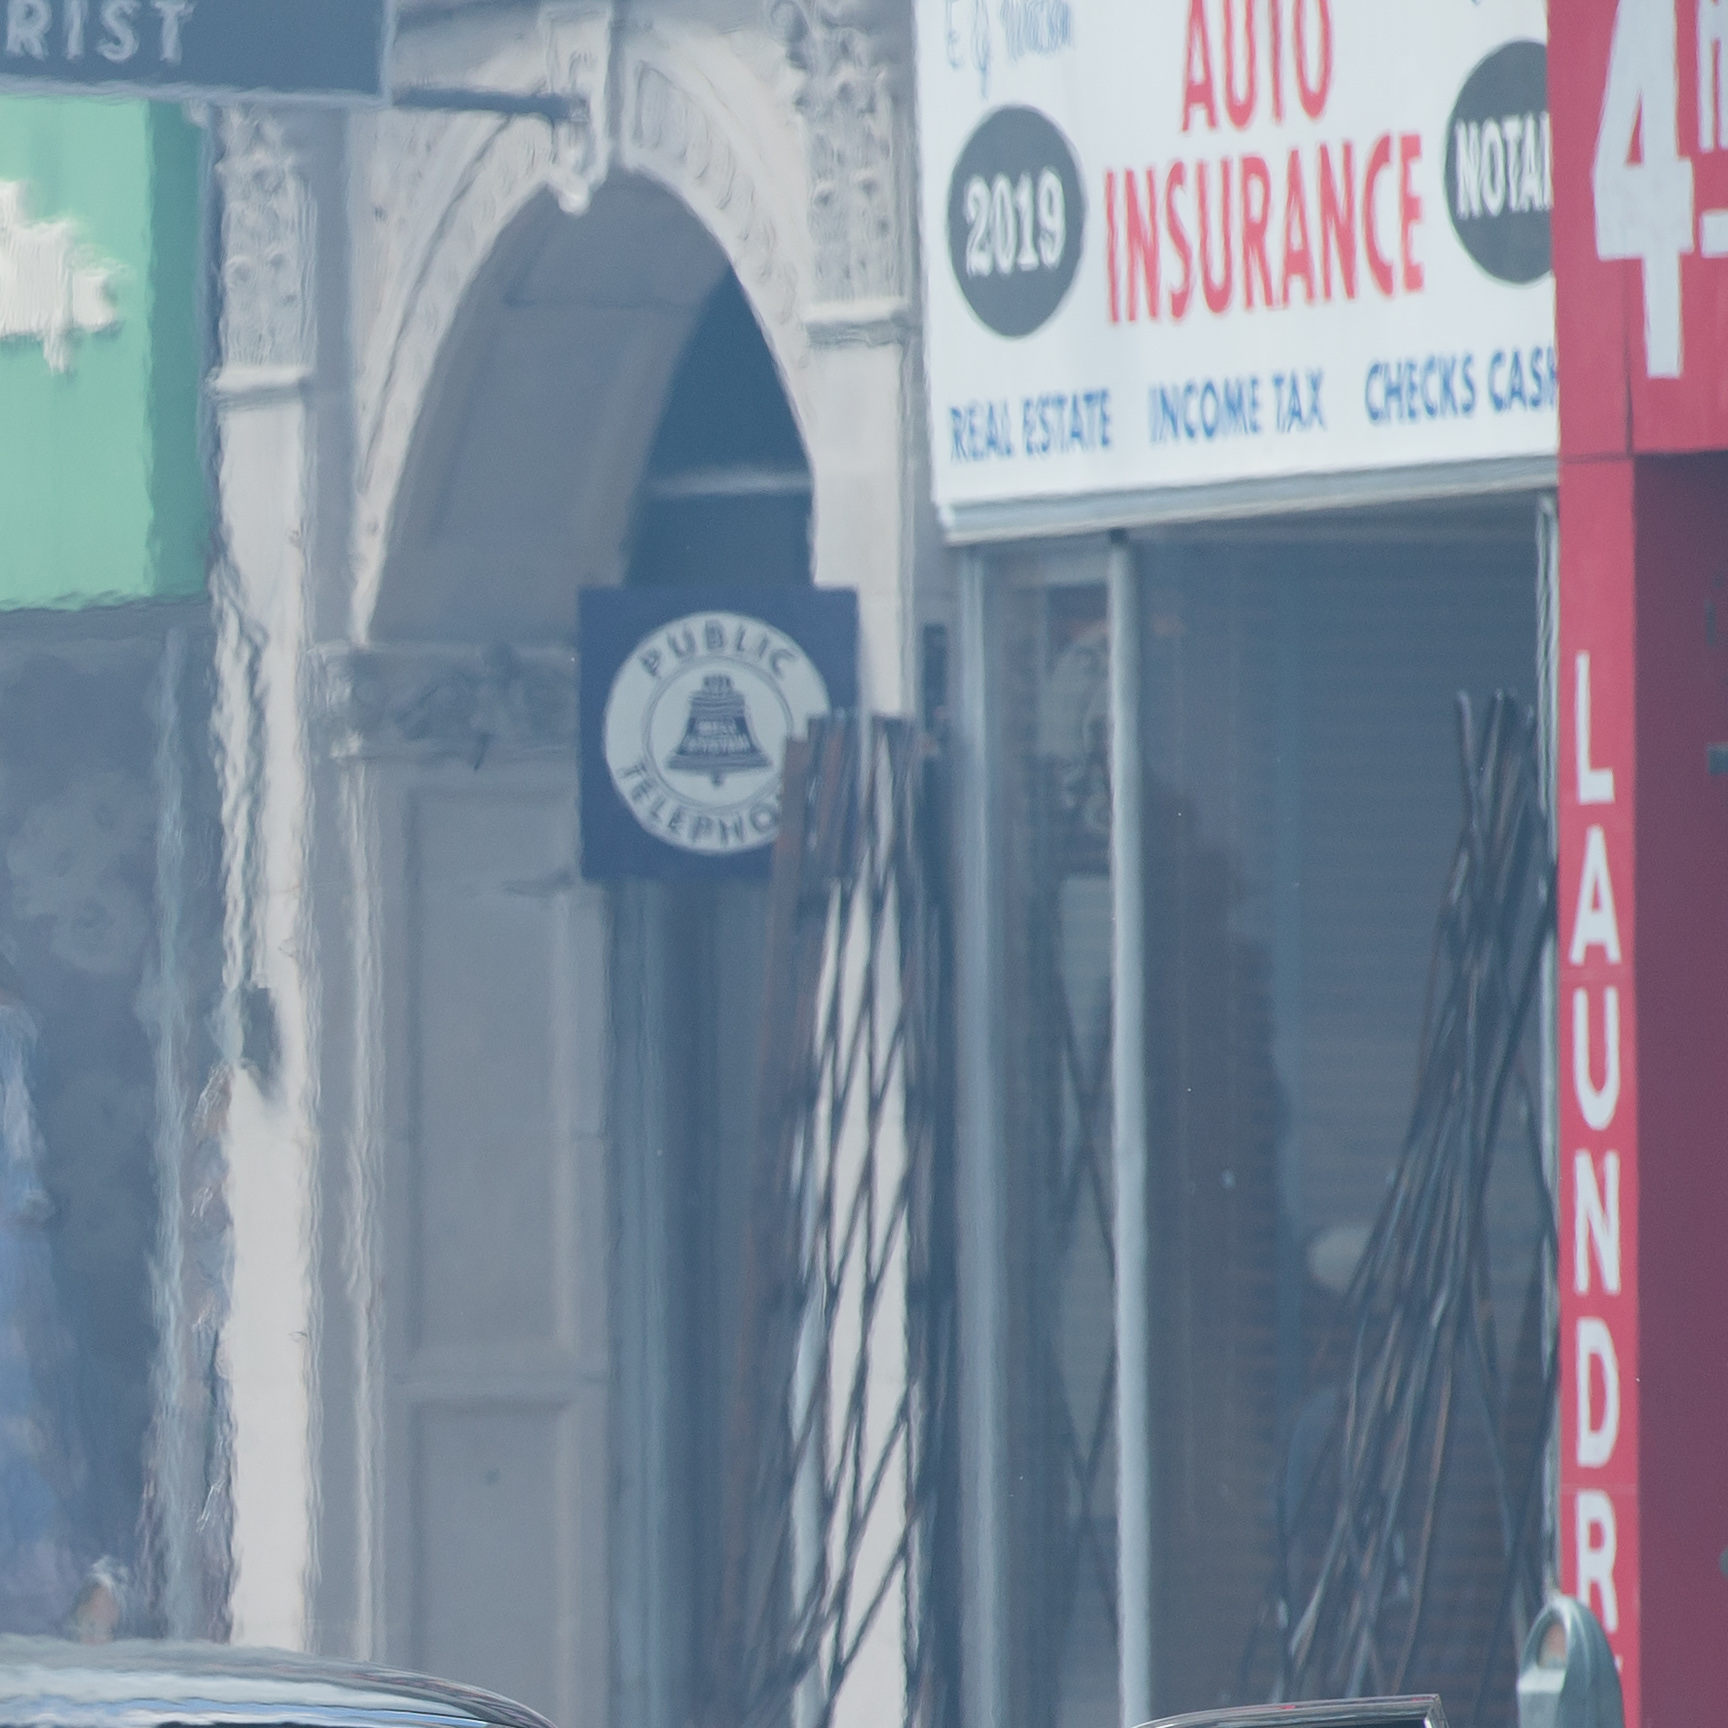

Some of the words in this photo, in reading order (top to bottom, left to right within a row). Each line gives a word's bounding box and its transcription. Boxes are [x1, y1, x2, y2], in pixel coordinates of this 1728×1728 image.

[1181, 0, 1333, 131] AUTO
[964, 167, 1066, 277] 2019
[1103, 133, 1425, 325] INSURANCE
[947, 401, 1013, 464] REAL
[1022, 388, 1112, 457] ESTATE
[1148, 375, 1261, 445] INCOME
[1272, 367, 1326, 433] TAX
[1365, 354, 1477, 426] CHECKS
[642, 619, 798, 678] PUBLIC
[619, 762, 780, 848] TELEPHO
[1568, 651, 1622, 1674] LAUNDR
